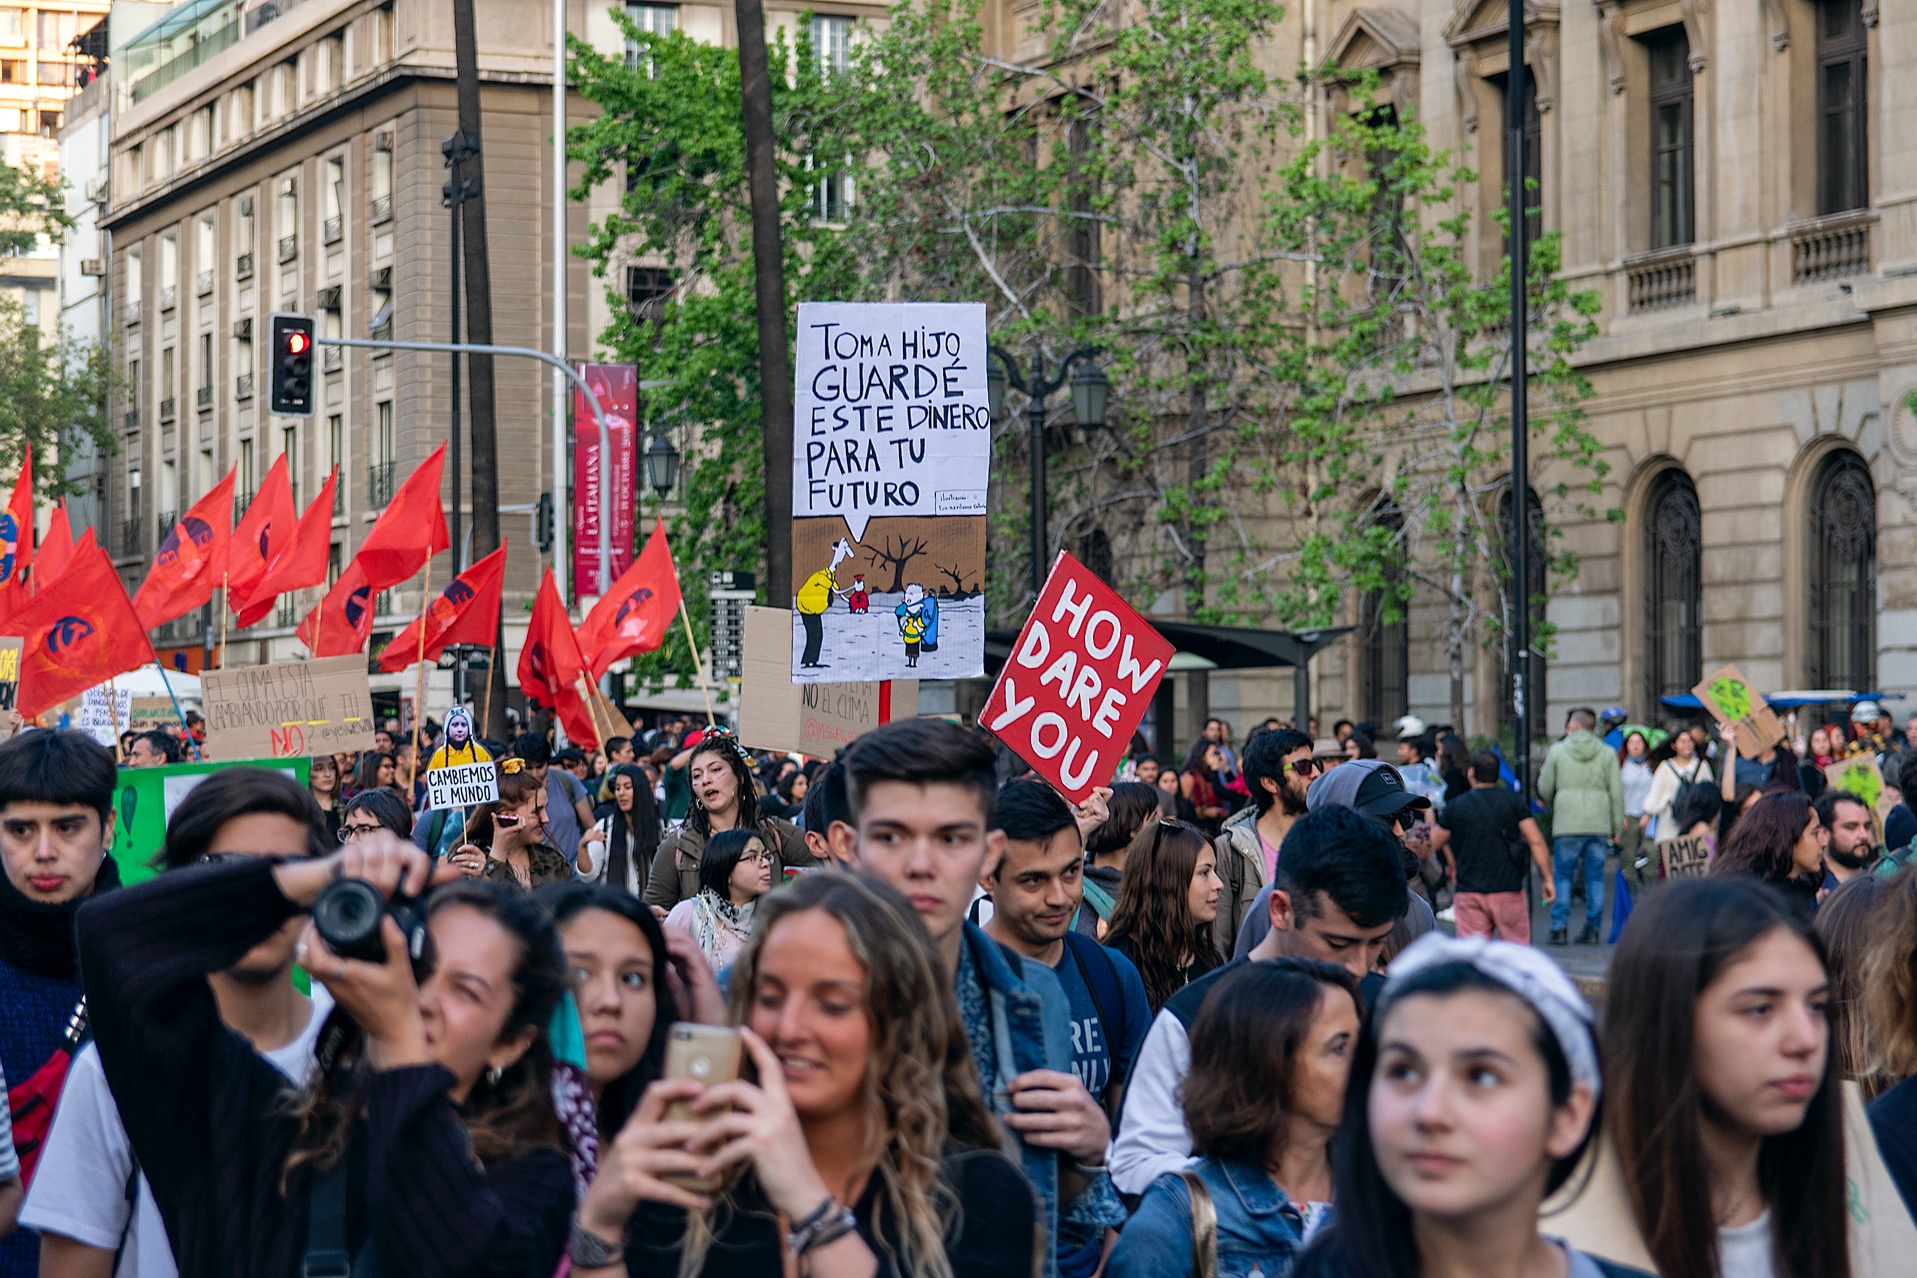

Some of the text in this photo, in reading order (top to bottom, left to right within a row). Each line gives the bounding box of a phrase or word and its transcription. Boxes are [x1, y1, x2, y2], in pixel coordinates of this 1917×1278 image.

[810, 323, 892, 360] TOMA
[812, 357, 968, 403] GUARDÉ
[811, 405, 894, 437] ESTE
[806, 438, 926, 479] PARA TU
[586, 444, 599, 512] ITALIANA
[809, 479, 920, 510] FUTURO
[1052, 578, 1161, 694] HOW
[205, 675, 229, 704] EL
[236, 669, 278, 700] CLIMA
[1017, 620, 1127, 739] DARE
[803, 684, 870, 724] NO EL CLIMA
[270, 725, 305, 756] NO
[990, 677, 1099, 791] YOU
[428, 766, 494, 786] CAMBIEMOS
[433, 785, 491, 805] EL MUNDO
